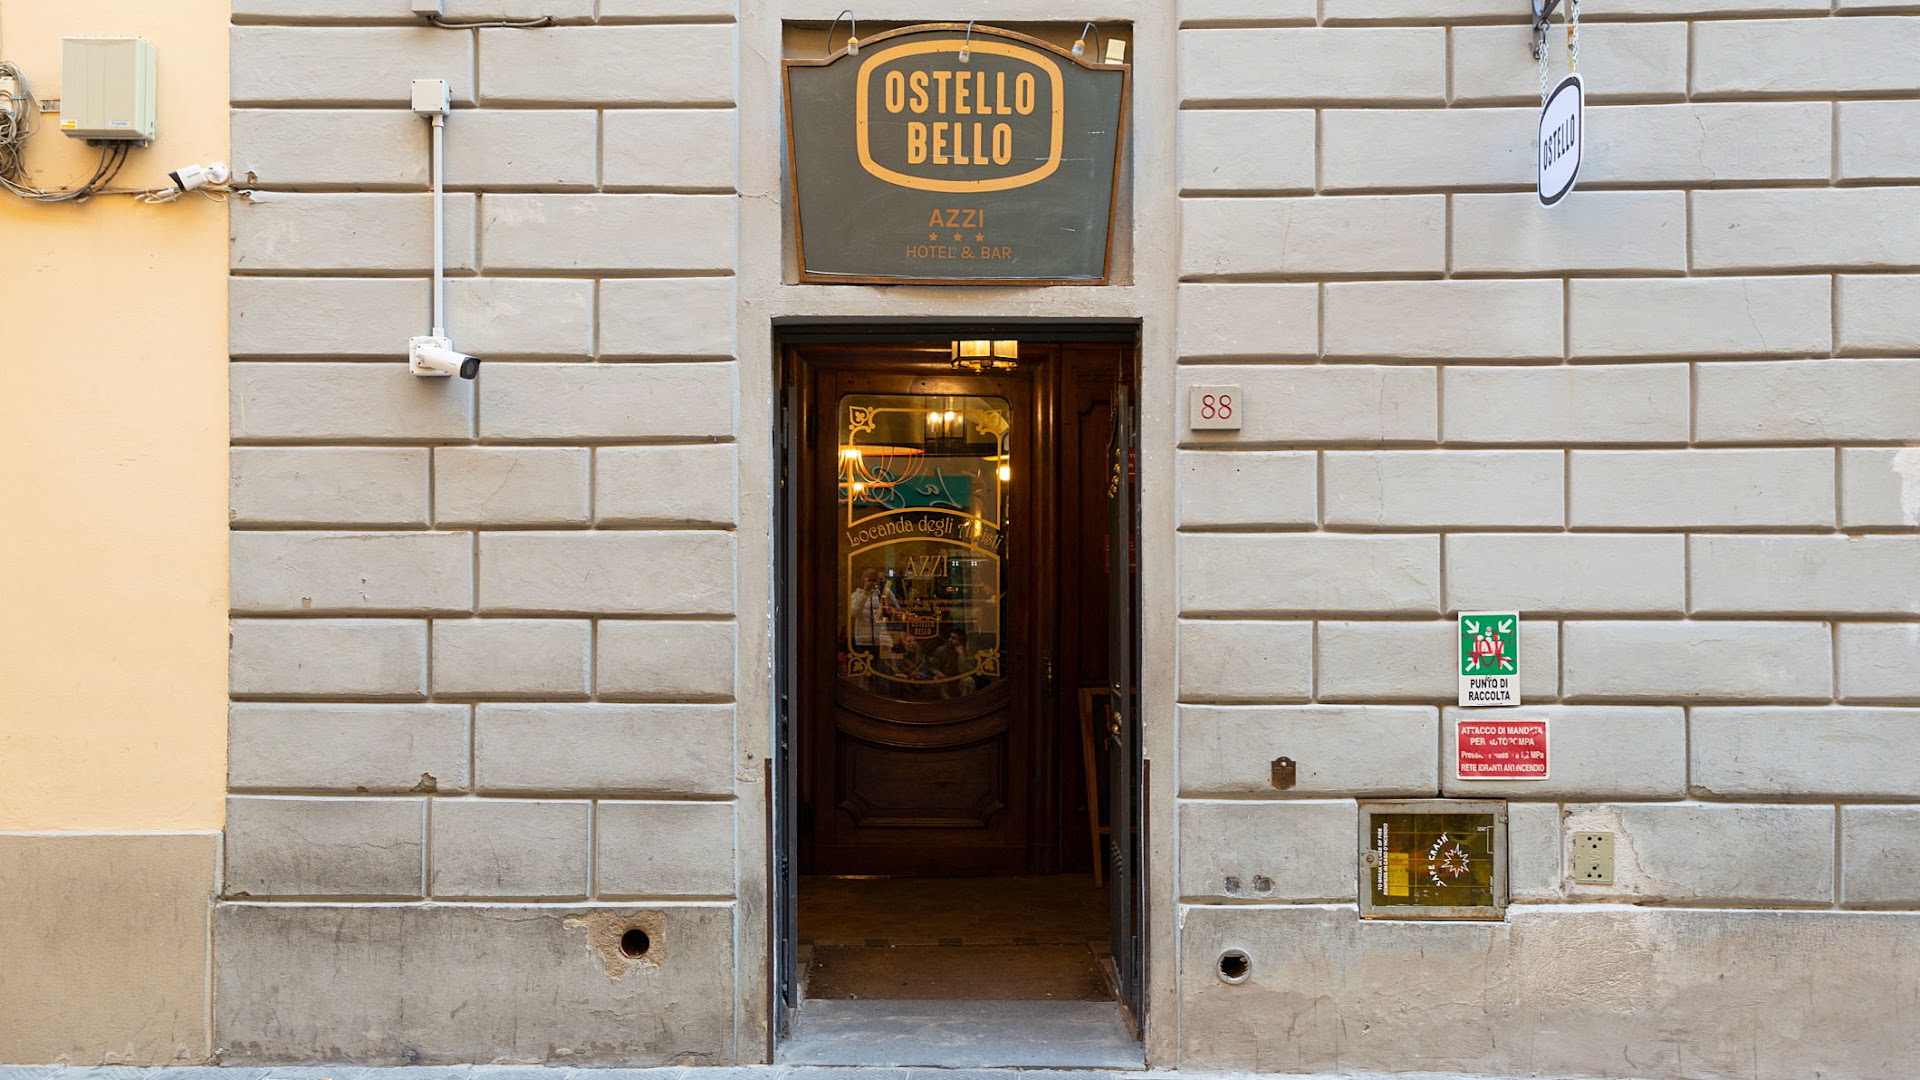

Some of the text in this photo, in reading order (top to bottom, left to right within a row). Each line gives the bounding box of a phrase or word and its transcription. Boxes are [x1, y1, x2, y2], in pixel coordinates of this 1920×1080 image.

[885, 70, 1035, 115] OSTELLO
[907, 121, 1013, 165] BELLO
[1543, 113, 1575, 171] OSTELLO
[928, 208, 984, 228] AZZI
[905, 245, 1012, 260] HOTEL & BAR
[1200, 394, 1232, 420] 88
[846, 515, 1004, 550] Locanda degli Aristi
[905, 555, 948, 577] AZZI
[1470, 678, 1508, 688] PUNTO DI
[1468, 690, 1511, 701] RACCOLTA
[1461, 726, 1497, 735] ATTACCO
[1498, 726, 1506, 735] DI
[1470, 737, 1486, 746] PER
[1461, 763, 1477, 772] RETE
[1428, 833, 1449, 887] SAFE CRASH
